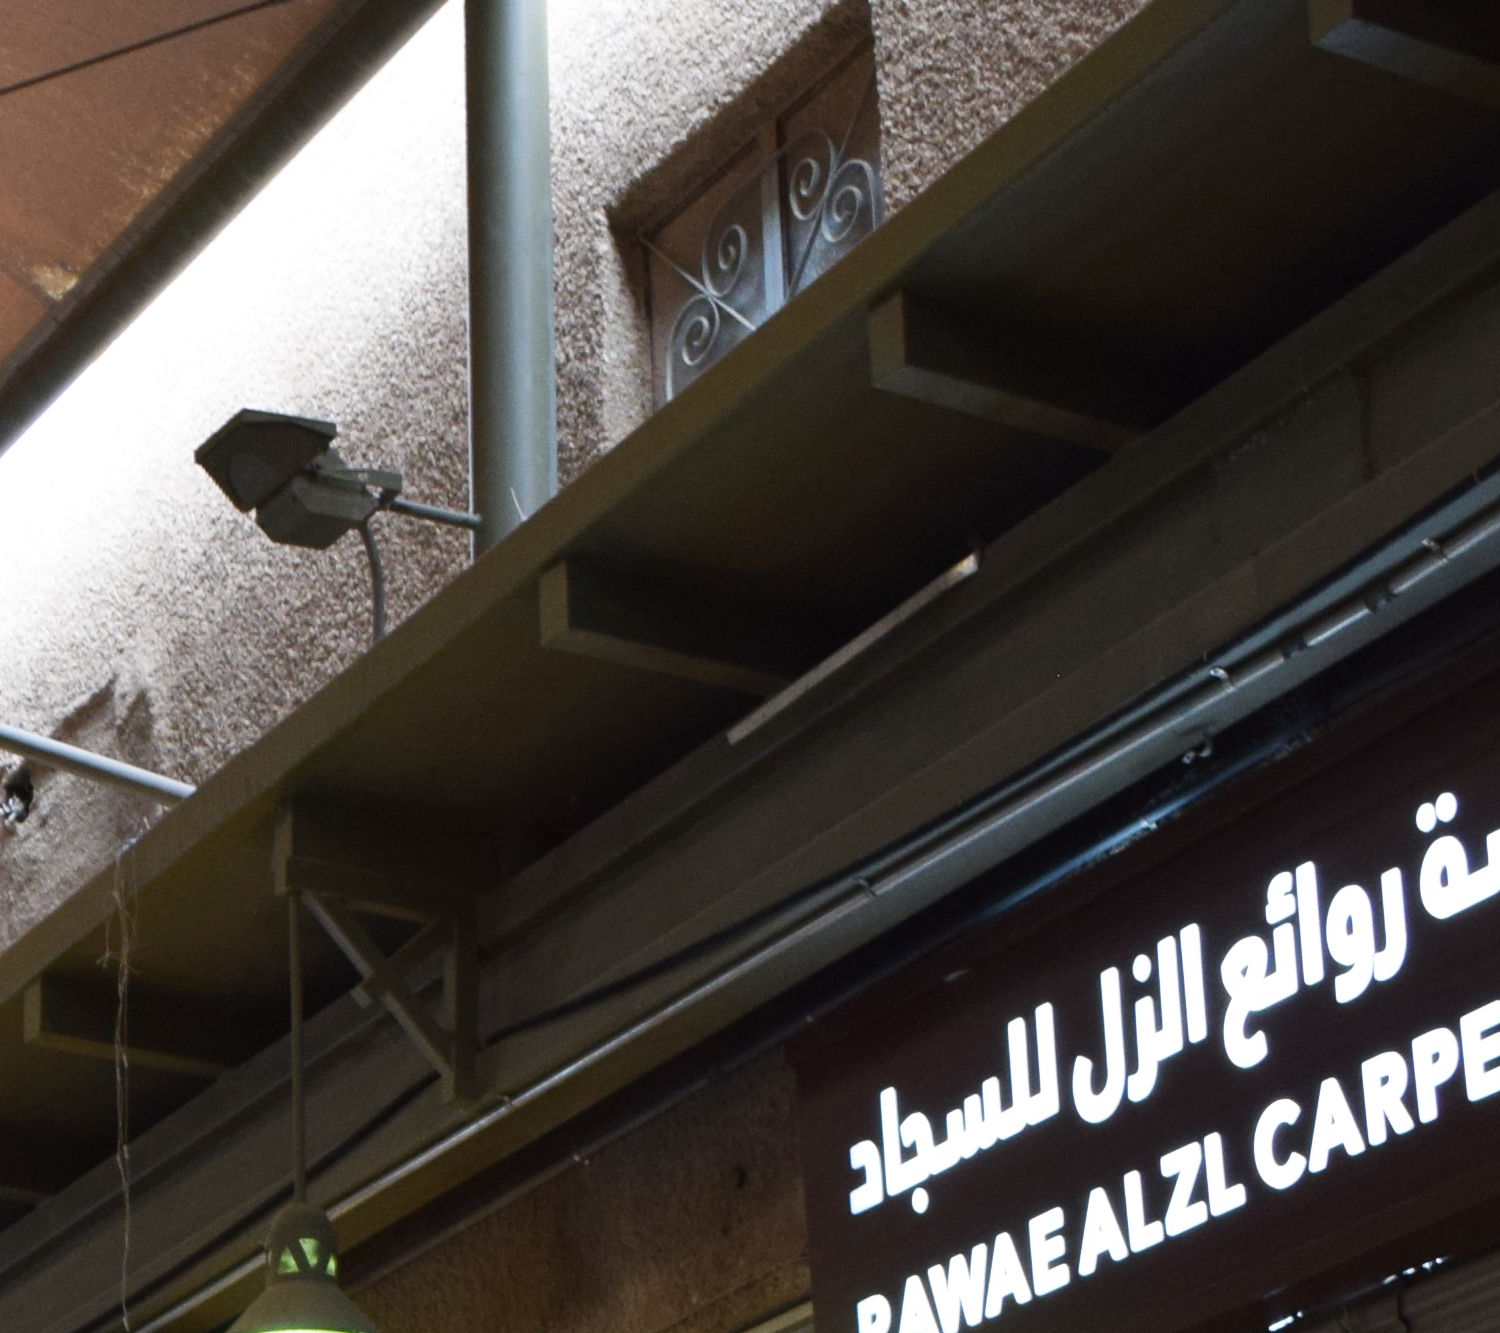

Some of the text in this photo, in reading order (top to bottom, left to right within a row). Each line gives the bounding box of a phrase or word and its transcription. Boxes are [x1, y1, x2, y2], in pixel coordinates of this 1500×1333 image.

[1072, 923, 1207, 1124] الزل
[1221, 861, 1407, 1069] روائع
[849, 1002, 1060, 1214] للسجاد
[1078, 1132, 1246, 1276] ALZL
